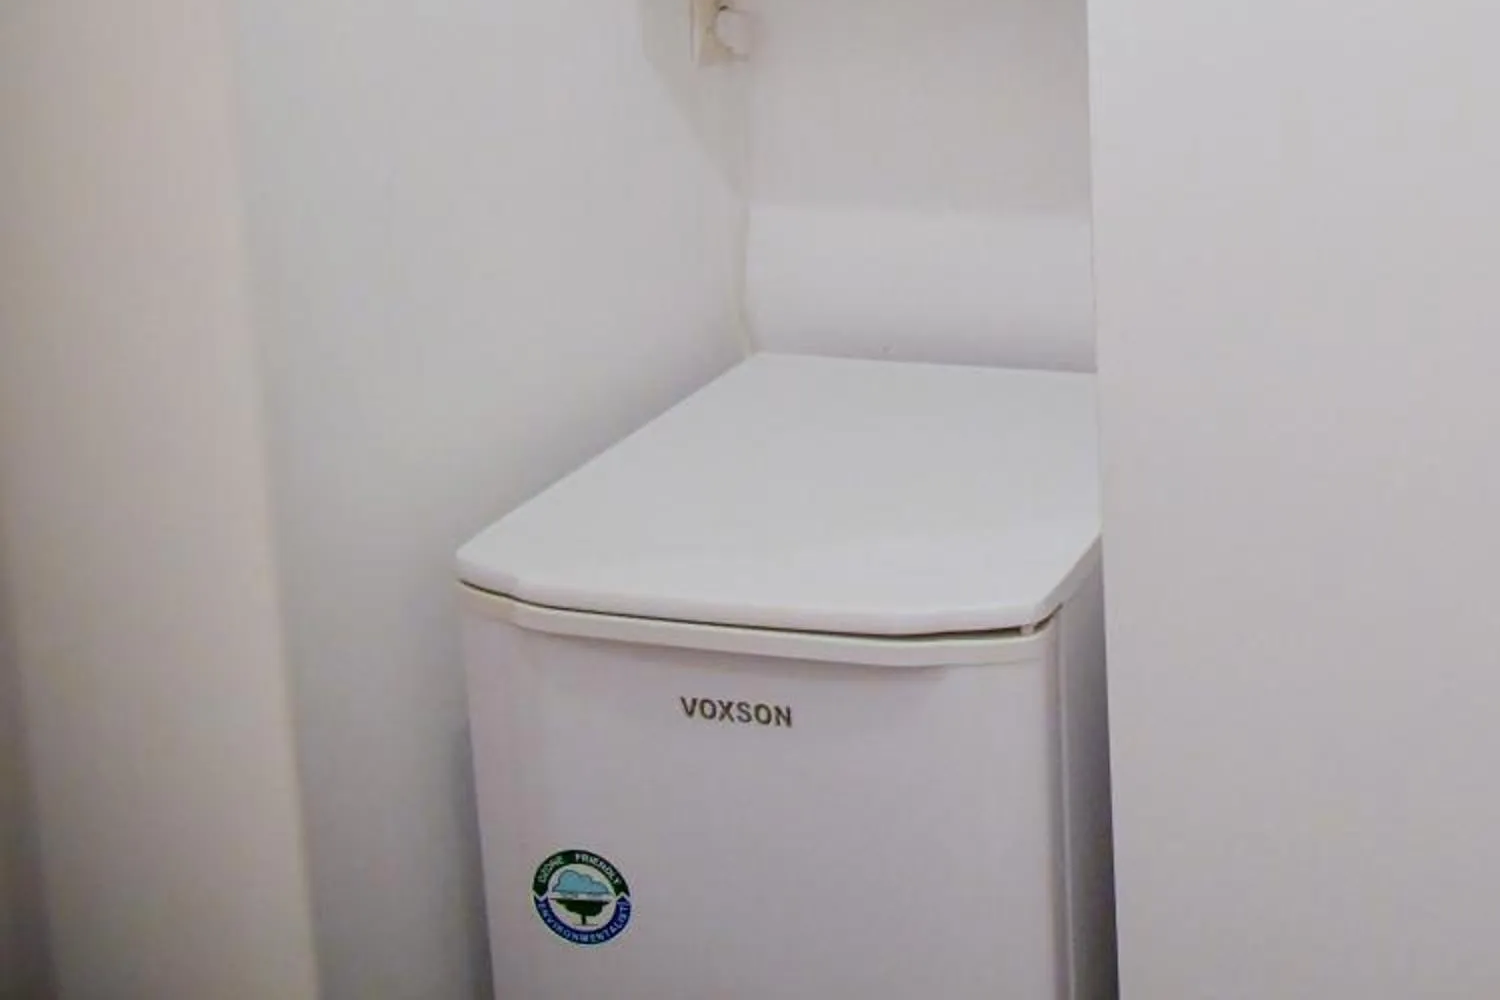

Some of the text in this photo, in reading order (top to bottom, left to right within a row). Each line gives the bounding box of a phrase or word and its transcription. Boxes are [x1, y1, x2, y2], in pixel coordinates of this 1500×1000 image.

[680, 696, 792, 727] VOXSON
[538, 853, 621, 885] OZONE FRIENDLY
